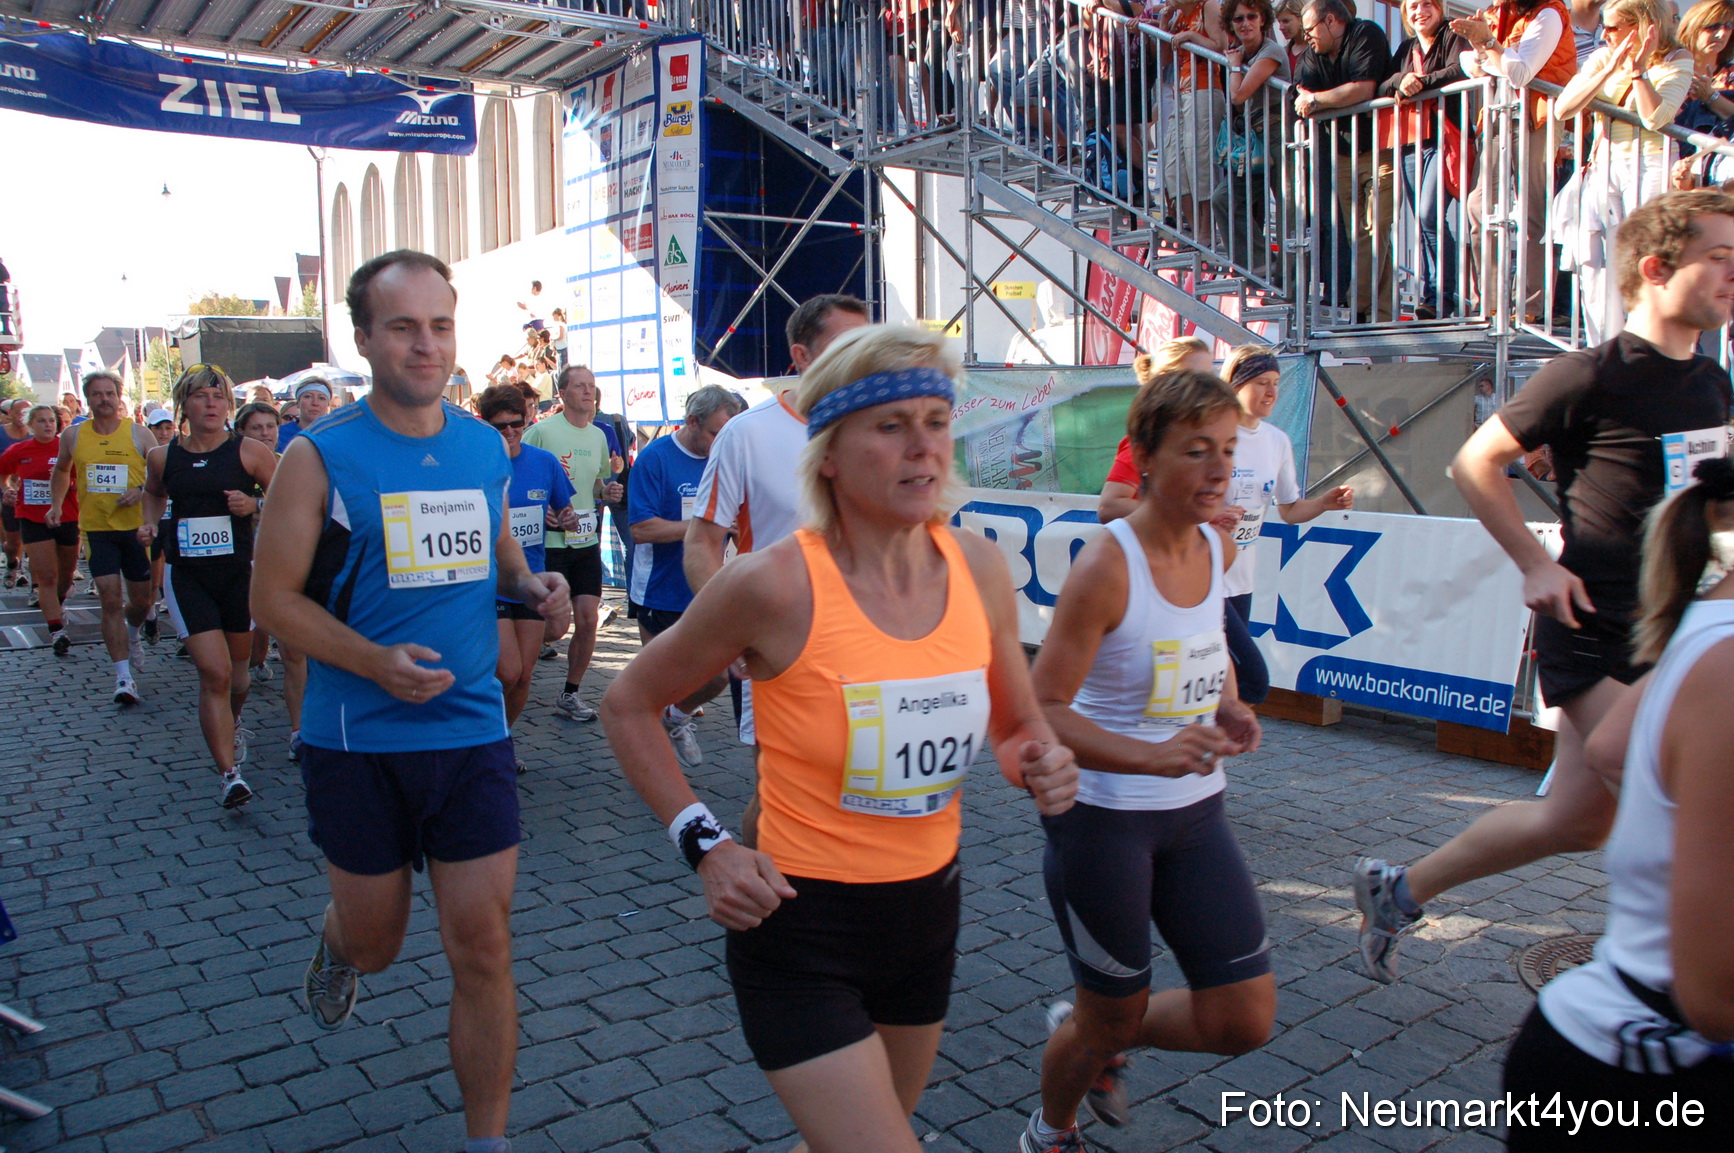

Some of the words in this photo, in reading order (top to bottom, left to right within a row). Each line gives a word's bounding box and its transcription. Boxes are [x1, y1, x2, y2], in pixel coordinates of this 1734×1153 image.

[158, 73, 302, 125] ZIEL
[388, 131, 466, 140] www.mizunoeurope.com
[950, 397, 987, 420] asser
[990, 398, 1016, 411] zum
[1022, 376, 1055, 410] Leben
[989, 426, 1009, 489] NEUMAR
[97, 475, 117, 484] 641
[34, 490, 52, 498] 285
[421, 501, 475, 516] Benjamin
[192, 531, 229, 545] 2008
[422, 530, 482, 558] 1056
[512, 523, 540, 537] 3503
[952, 500, 1383, 650] BOK
[1316, 668, 1506, 717] www.bockonline.de
[896, 732, 973, 779] 1021
